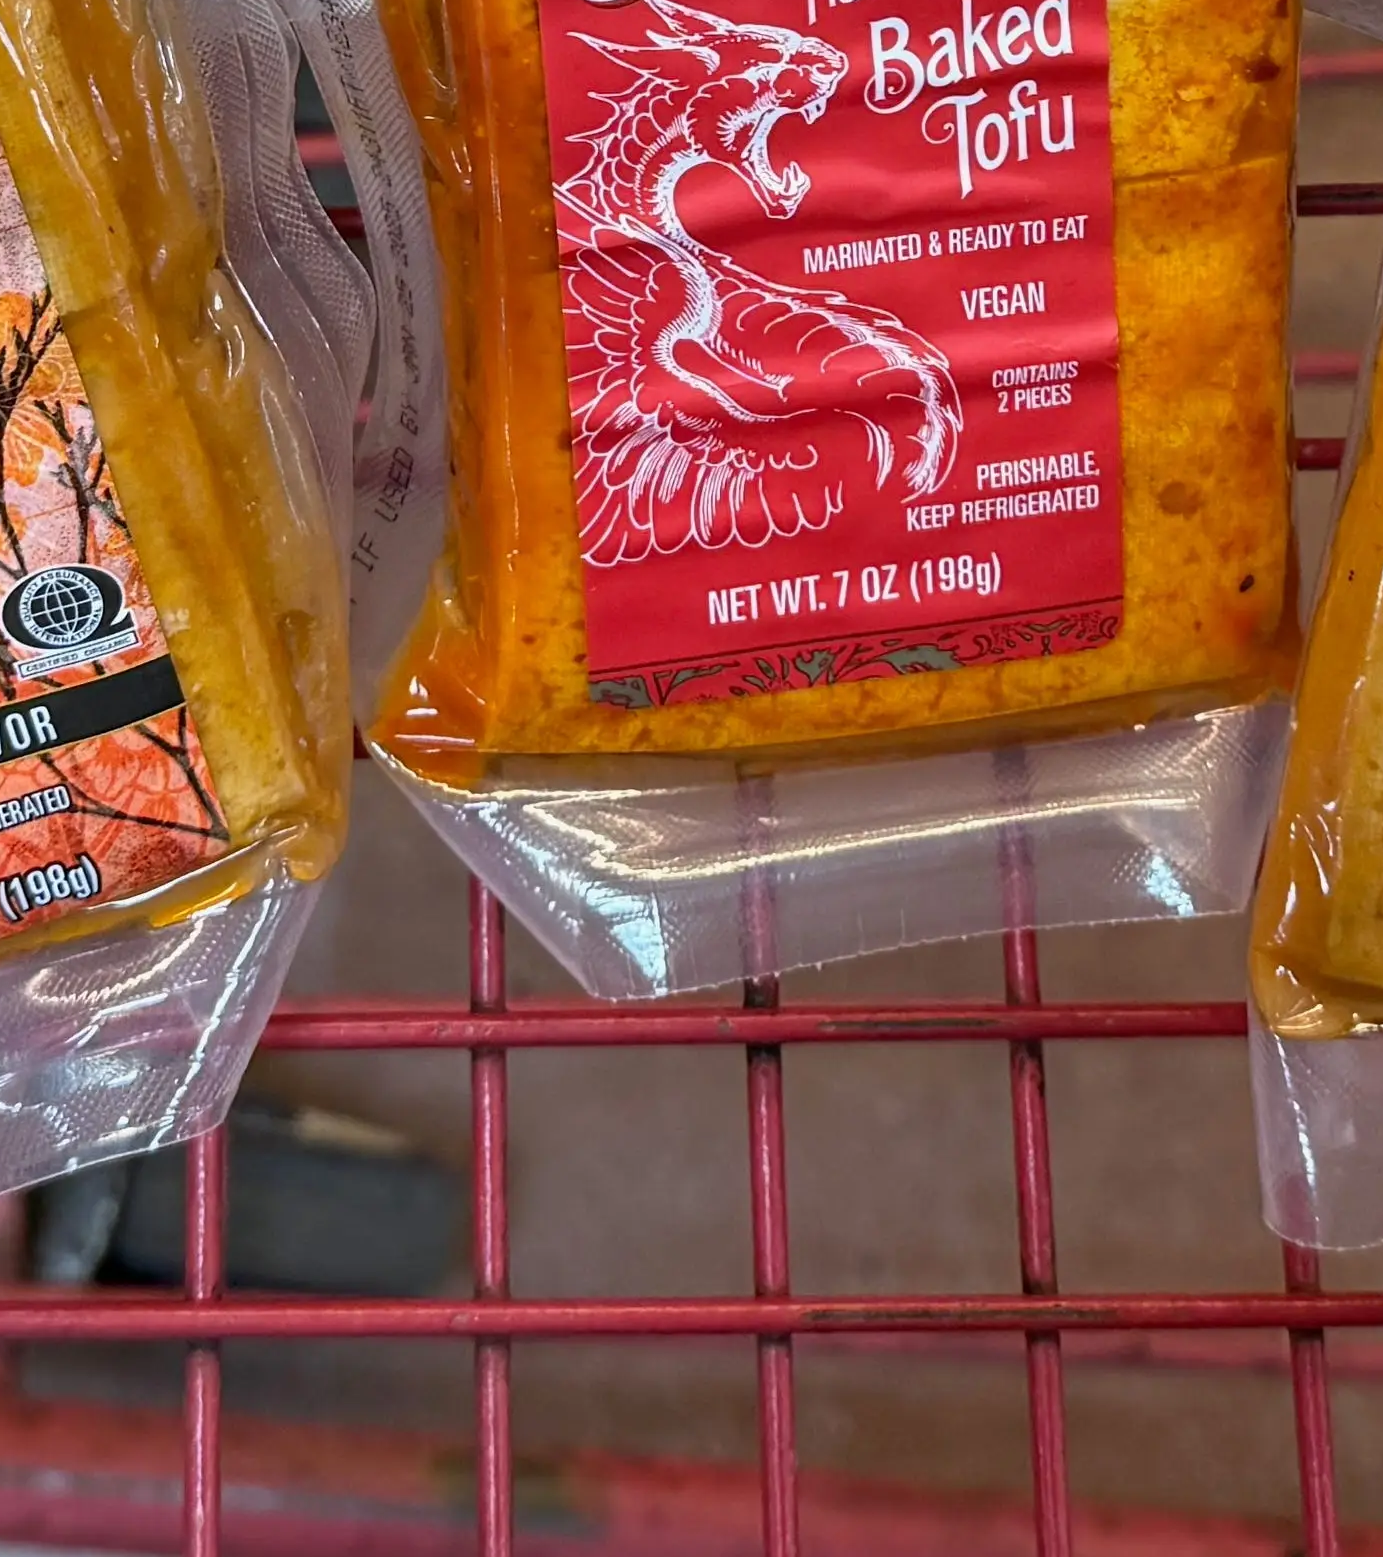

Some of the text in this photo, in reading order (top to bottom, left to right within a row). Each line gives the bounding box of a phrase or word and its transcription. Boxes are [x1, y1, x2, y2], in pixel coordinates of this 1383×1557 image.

[921, 79, 1076, 200] Tofu
[804, 215, 1089, 275] MARINATED & READY TO EAT
[960, 282, 1046, 321] VEGAN
[992, 360, 1079, 389] CONTAINS
[997, 384, 1072, 414] 2 PIECES
[976, 451, 1100, 491] PERISHABLE,
[351, 532, 380, 573] IF
[375, 447, 414, 523] USED
[906, 485, 1100, 532] KEEP REFRIGERATED
[20, 582, 39, 622] QUALITY
[40, 570, 101, 600] ASSURANCE
[708, 552, 1002, 625] NET WT. 7 OZ (198g)
